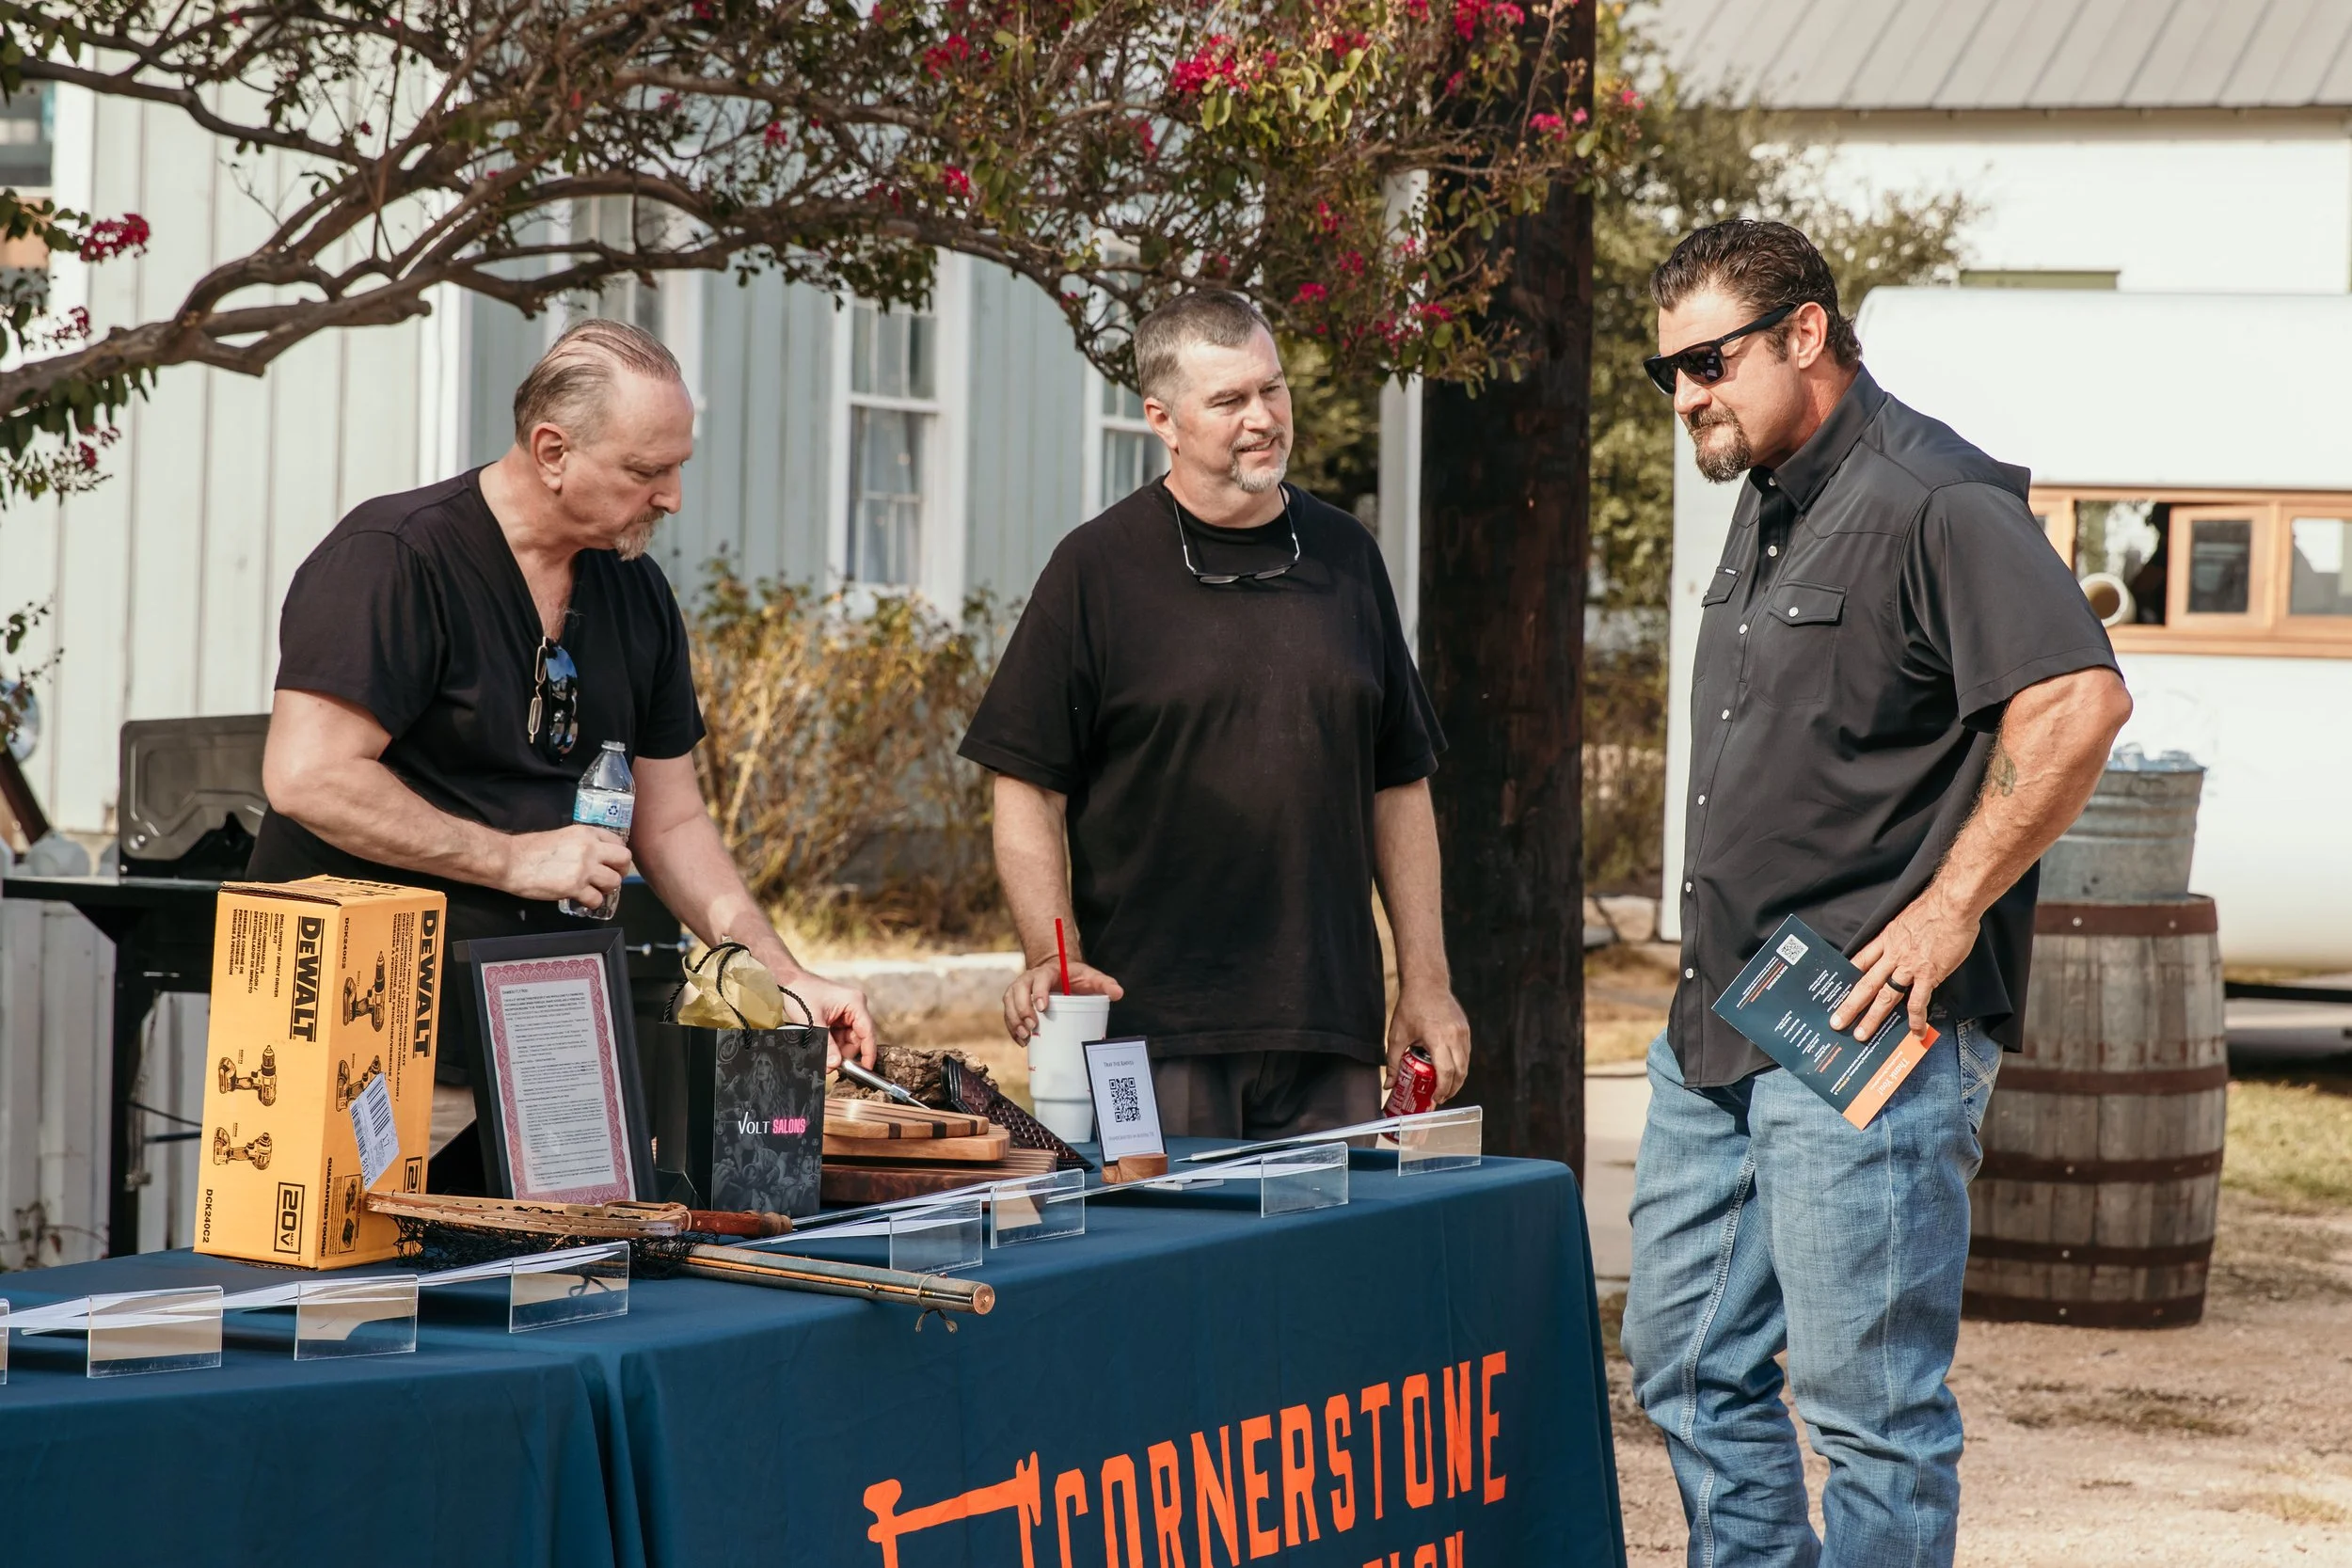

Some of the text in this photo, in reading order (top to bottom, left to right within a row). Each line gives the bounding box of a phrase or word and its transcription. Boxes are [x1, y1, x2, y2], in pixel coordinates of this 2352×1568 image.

[293, 916, 322, 1042] DEWALT
[415, 911, 437, 1057] DEWALT
[1888, 1056, 1910, 1081] Thank
[739, 1111, 806, 1134] VOLT SALONS
[203, 1189, 213, 1243] DCK240C2
[324, 1157, 332, 1219] GUARANTEED
[1055, 1351, 1505, 1568] CORNERSTONE
